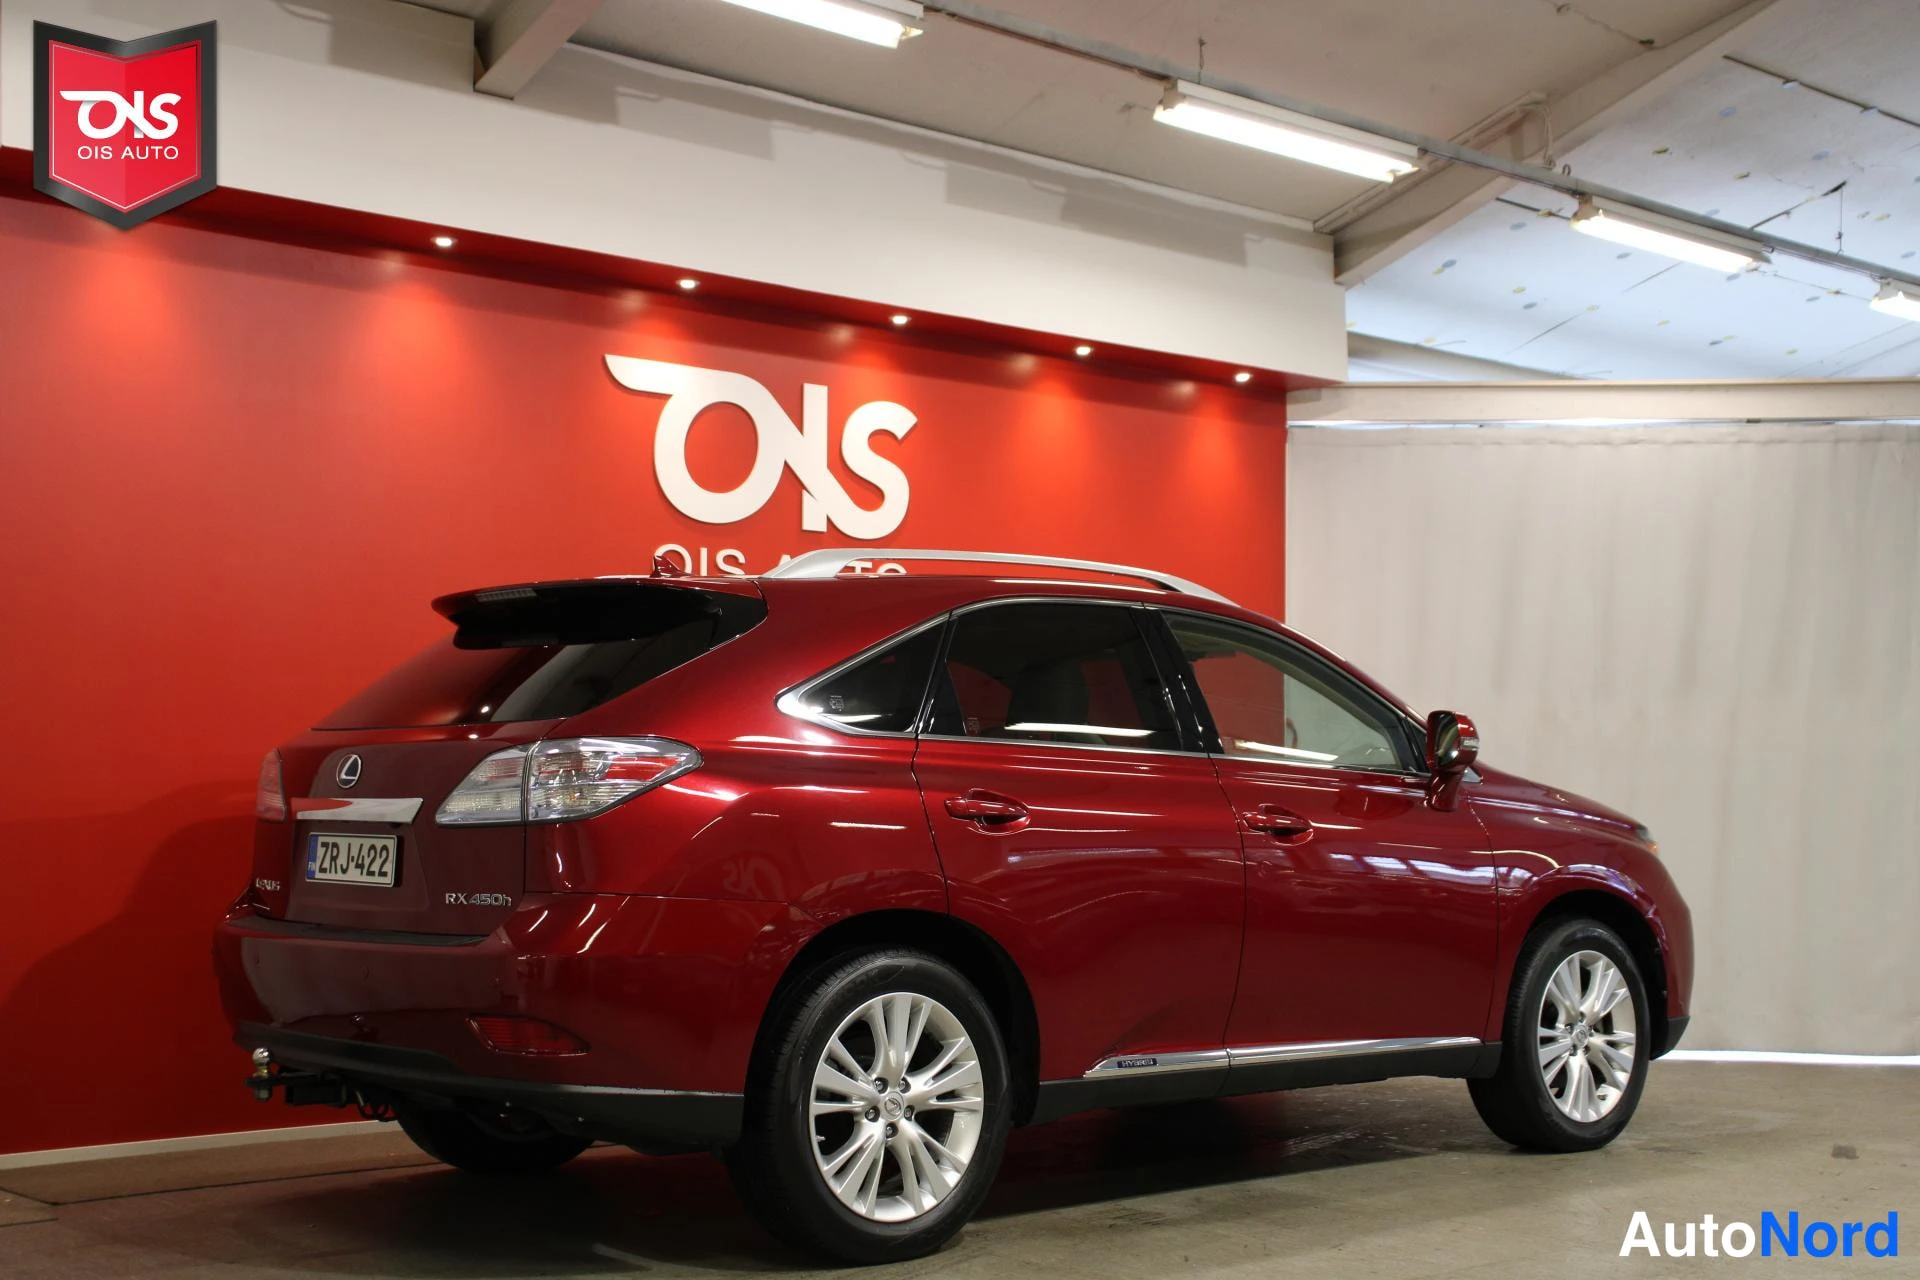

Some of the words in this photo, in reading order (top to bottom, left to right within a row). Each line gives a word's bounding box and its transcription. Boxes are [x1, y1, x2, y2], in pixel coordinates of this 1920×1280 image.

[319, 841, 390, 877] ZRJ-422
[445, 892, 468, 905] RX
[469, 893, 512, 906] 450h
